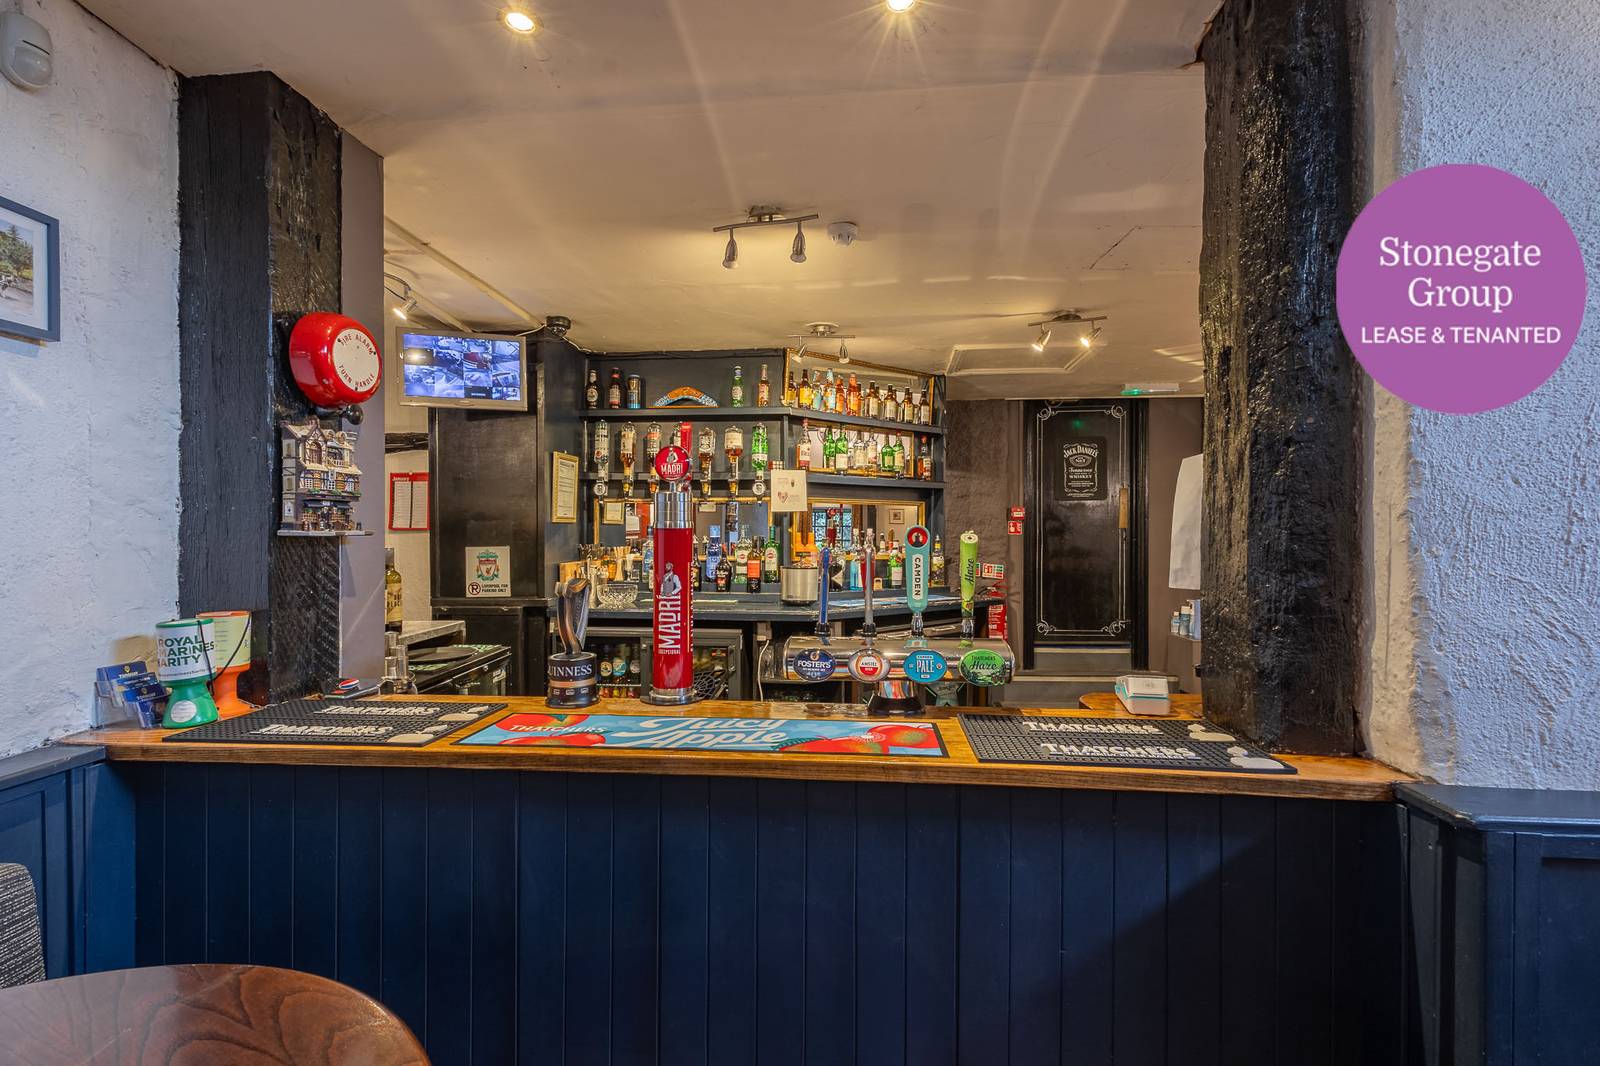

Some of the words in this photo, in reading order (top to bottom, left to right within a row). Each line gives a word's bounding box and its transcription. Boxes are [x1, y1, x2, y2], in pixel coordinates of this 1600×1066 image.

[339, 333, 352, 346] FIRE
[355, 333, 373, 355] ALARM
[339, 364, 352, 383] TURN
[355, 374, 375, 387] HANDLE
[1063, 447, 1077, 458] JACK
[964, 558, 975, 585] Haze
[158, 635, 204, 648] ROYAL
[797, 660, 831, 669] FOSTER'S
[916, 659, 935, 673] PALE
[970, 660, 997, 671] Haze
[508, 724, 609, 734] THATCHERS
[611, 718, 788, 737] Juicy
[1023, 721, 1160, 735] THATCHERS
[592, 730, 789, 748] Apple
[1041, 743, 1197, 758] THATCHERS
